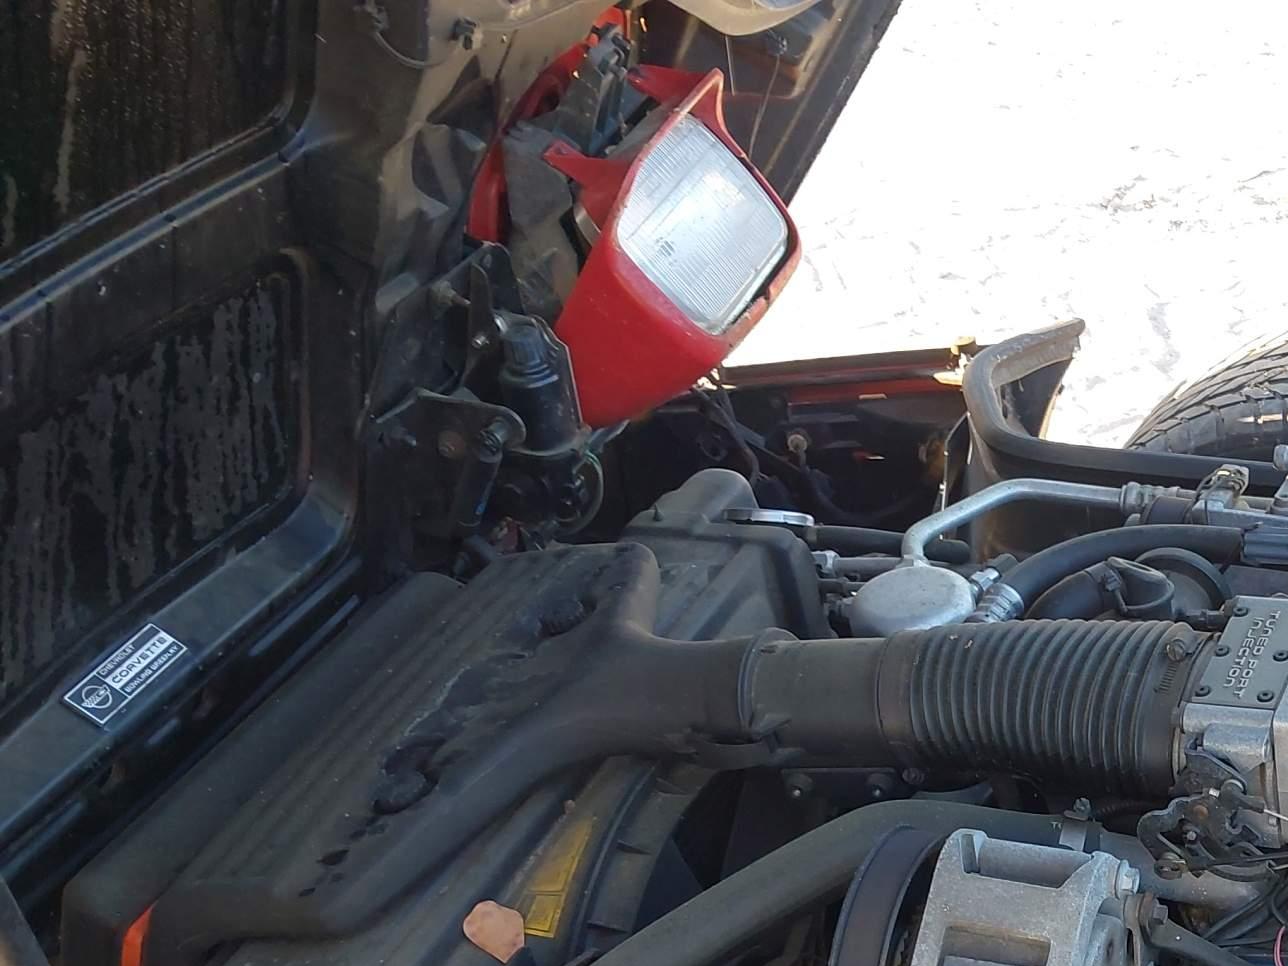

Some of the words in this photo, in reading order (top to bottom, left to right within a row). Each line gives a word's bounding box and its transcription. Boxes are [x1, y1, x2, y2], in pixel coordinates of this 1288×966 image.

[1223, 617, 1265, 688] INJECTION
[1252, 610, 1281, 656] TUNED
[99, 644, 136, 676] CHEVROLET
[111, 636, 168, 683] CORVETTE
[124, 668, 153, 693] BOWLING
[1233, 658, 1257, 698] PORT
